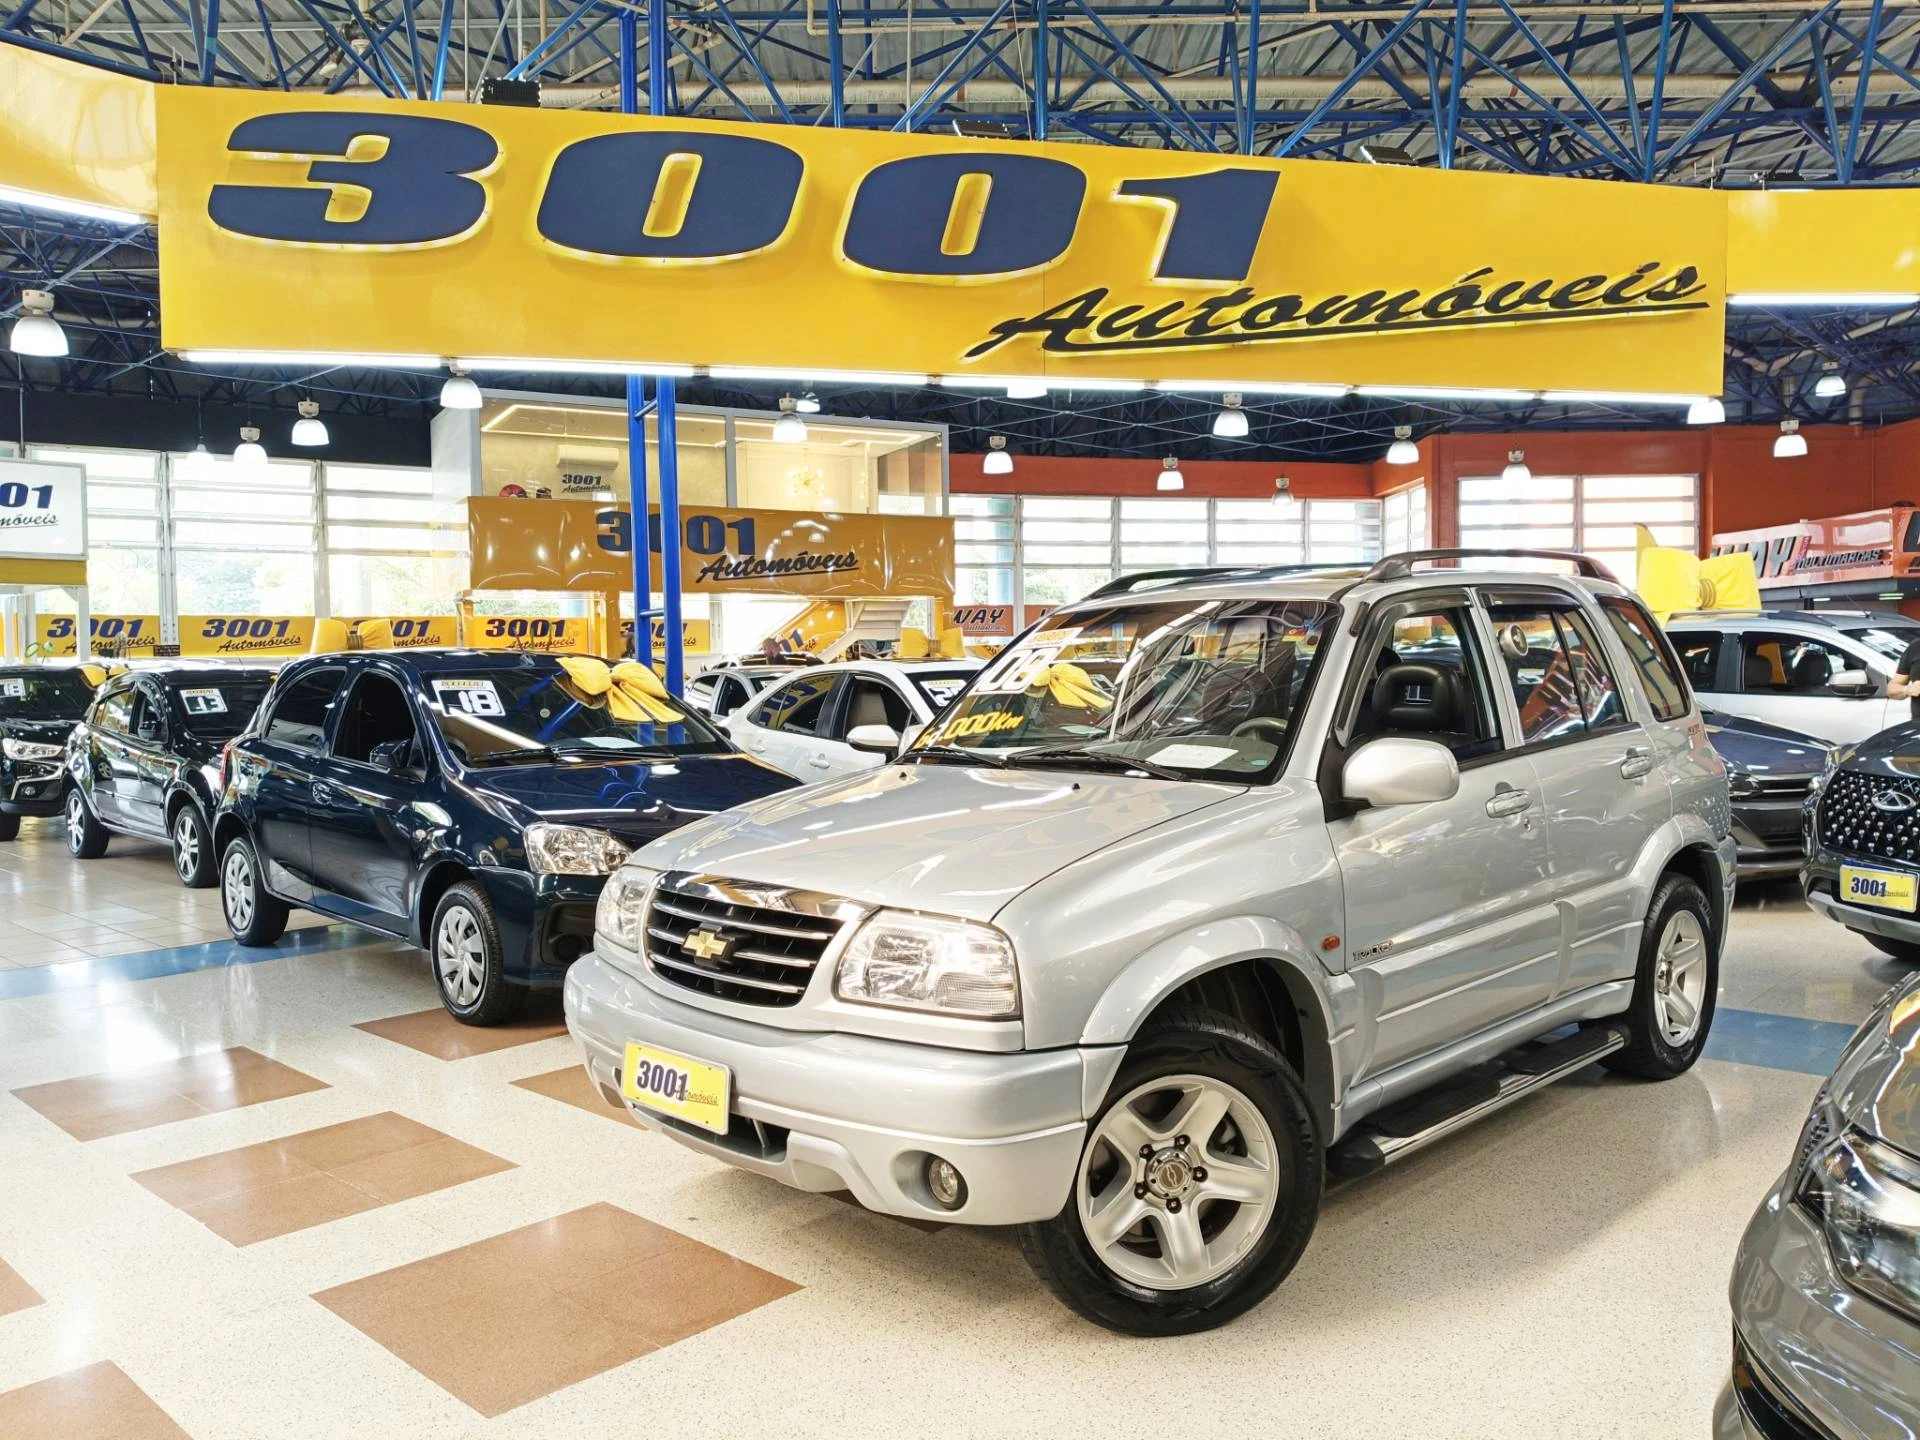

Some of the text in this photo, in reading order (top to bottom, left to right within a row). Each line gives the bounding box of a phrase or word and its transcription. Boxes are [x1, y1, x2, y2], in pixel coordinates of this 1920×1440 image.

[207, 111, 1280, 284] 3001
[965, 261, 1711, 358] Automóveis
[562, 474, 602, 485] 3001
[0, 482, 53, 509] 01
[696, 551, 860, 584] Automóveis
[202, 618, 290, 638] 3001
[485, 618, 566, 638] 3001
[217, 635, 303, 653] Automóveis
[457, 690, 502, 714] 18
[1851, 877, 1887, 897] 3001
[637, 1060, 688, 1102] 3001
